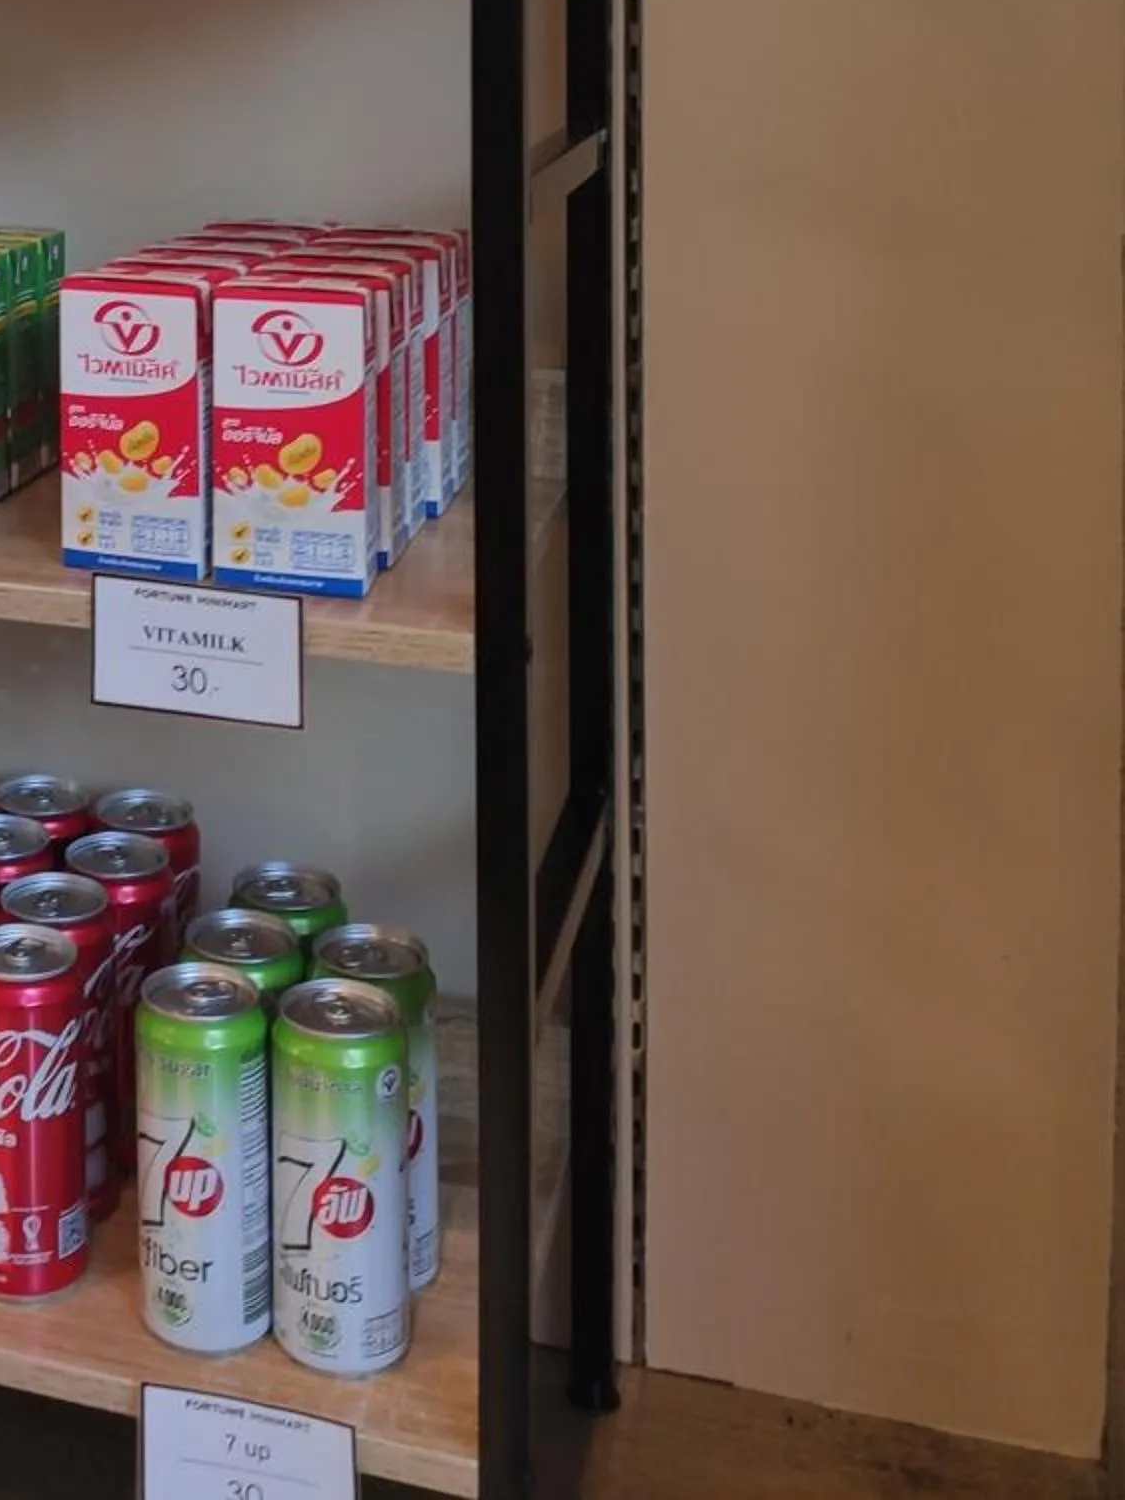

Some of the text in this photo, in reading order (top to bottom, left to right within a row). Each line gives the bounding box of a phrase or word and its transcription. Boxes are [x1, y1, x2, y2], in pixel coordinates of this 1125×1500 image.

[142, 624, 246, 654] VITAMILK
[169, 1165, 217, 1211] up
[143, 1236, 215, 1284] fiber
[224, 1433, 272, 1462] 7 up
